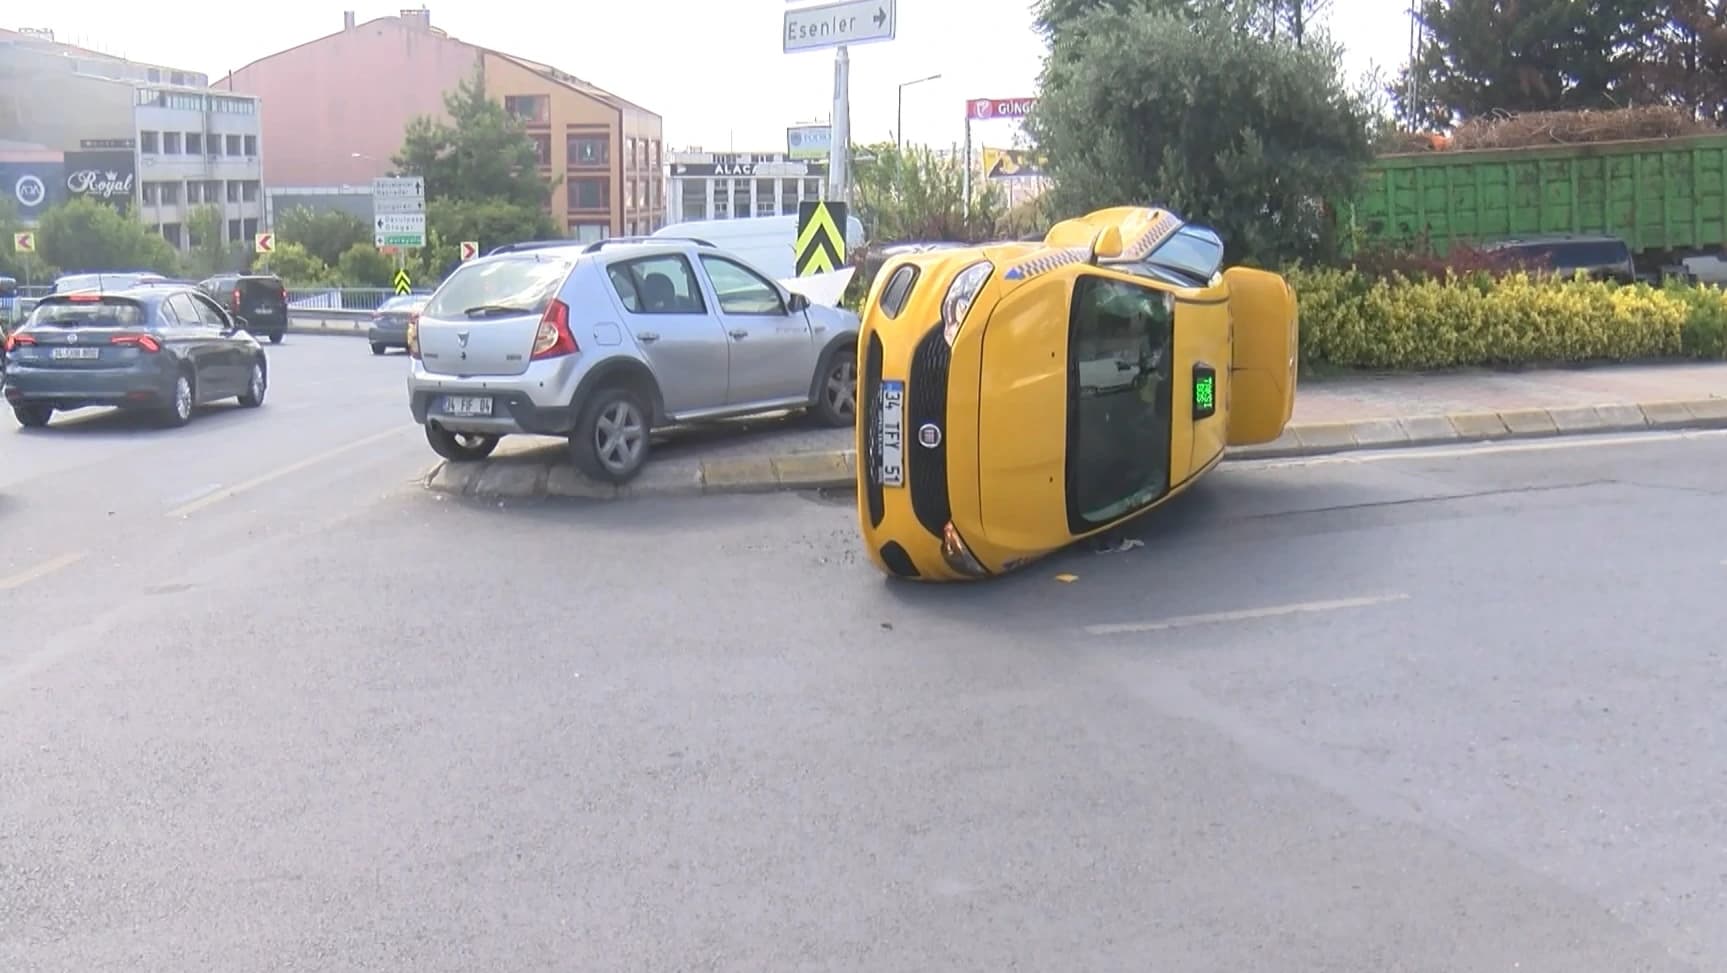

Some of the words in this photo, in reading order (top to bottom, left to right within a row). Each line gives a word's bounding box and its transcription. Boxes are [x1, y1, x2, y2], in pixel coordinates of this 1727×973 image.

[788, 16, 856, 40] Esenler
[67, 170, 133, 198] Royal
[885, 391, 900, 410] 34
[885, 421, 900, 450] TFY
[885, 465, 900, 483] 51
